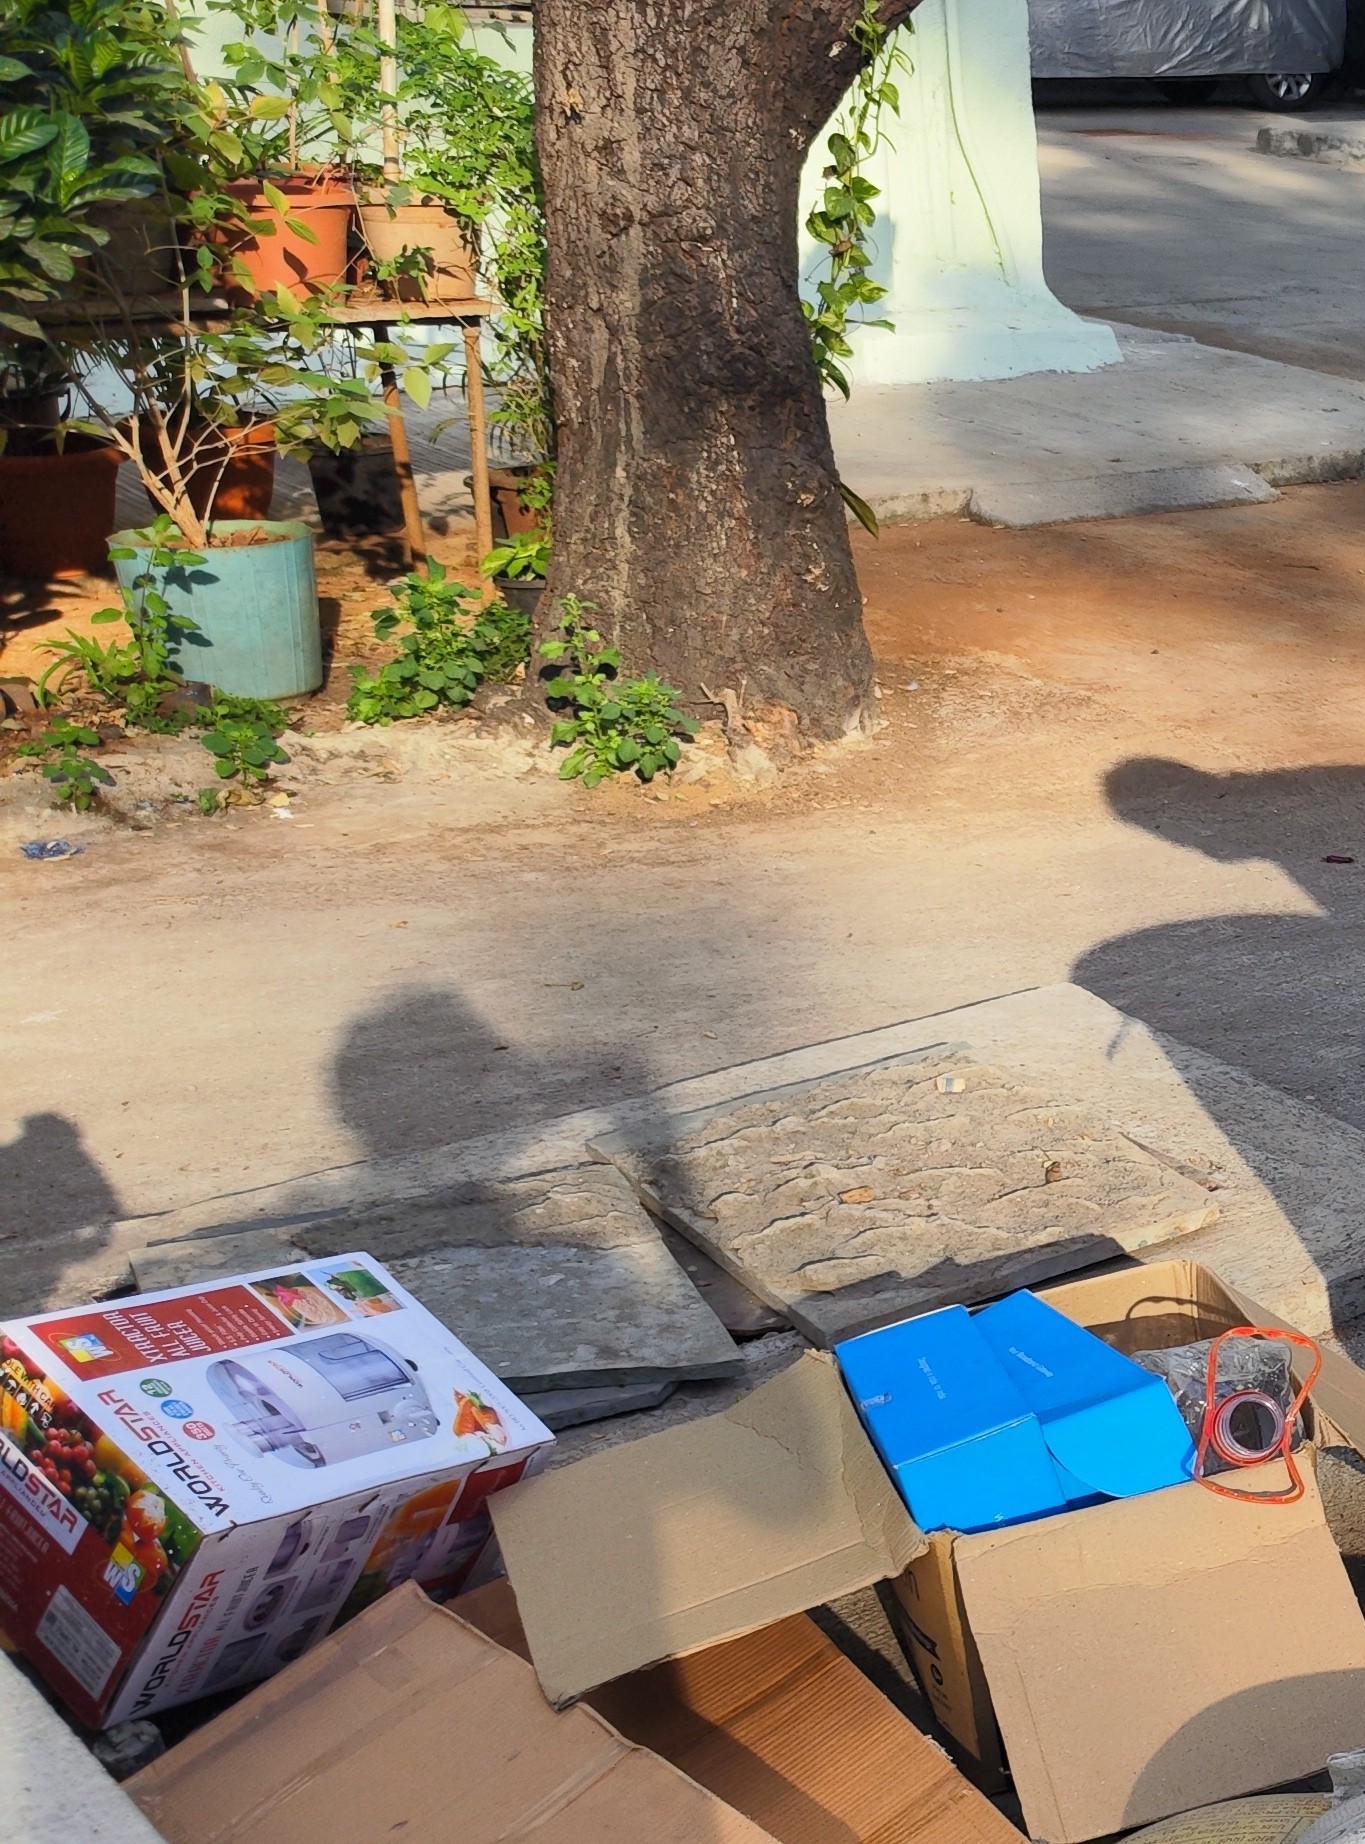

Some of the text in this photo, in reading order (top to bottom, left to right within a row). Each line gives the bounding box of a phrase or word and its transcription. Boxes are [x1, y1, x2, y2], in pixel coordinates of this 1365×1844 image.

[101, 1309, 167, 1363] XTRACTOR
[128, 1310, 190, 1358] ALL FRUIT
[165, 1319, 211, 1353] JUICER
[94, 1388, 234, 1518] WORLDSTAR
[140, 1409, 192, 1457] APPLIANCES
[187, 1457, 227, 1492] KITCHEN
[102, 1562, 141, 1593] WS
[128, 1567, 226, 1715] WORLDSTAR
[173, 1634, 223, 1694] XTRACTOR
